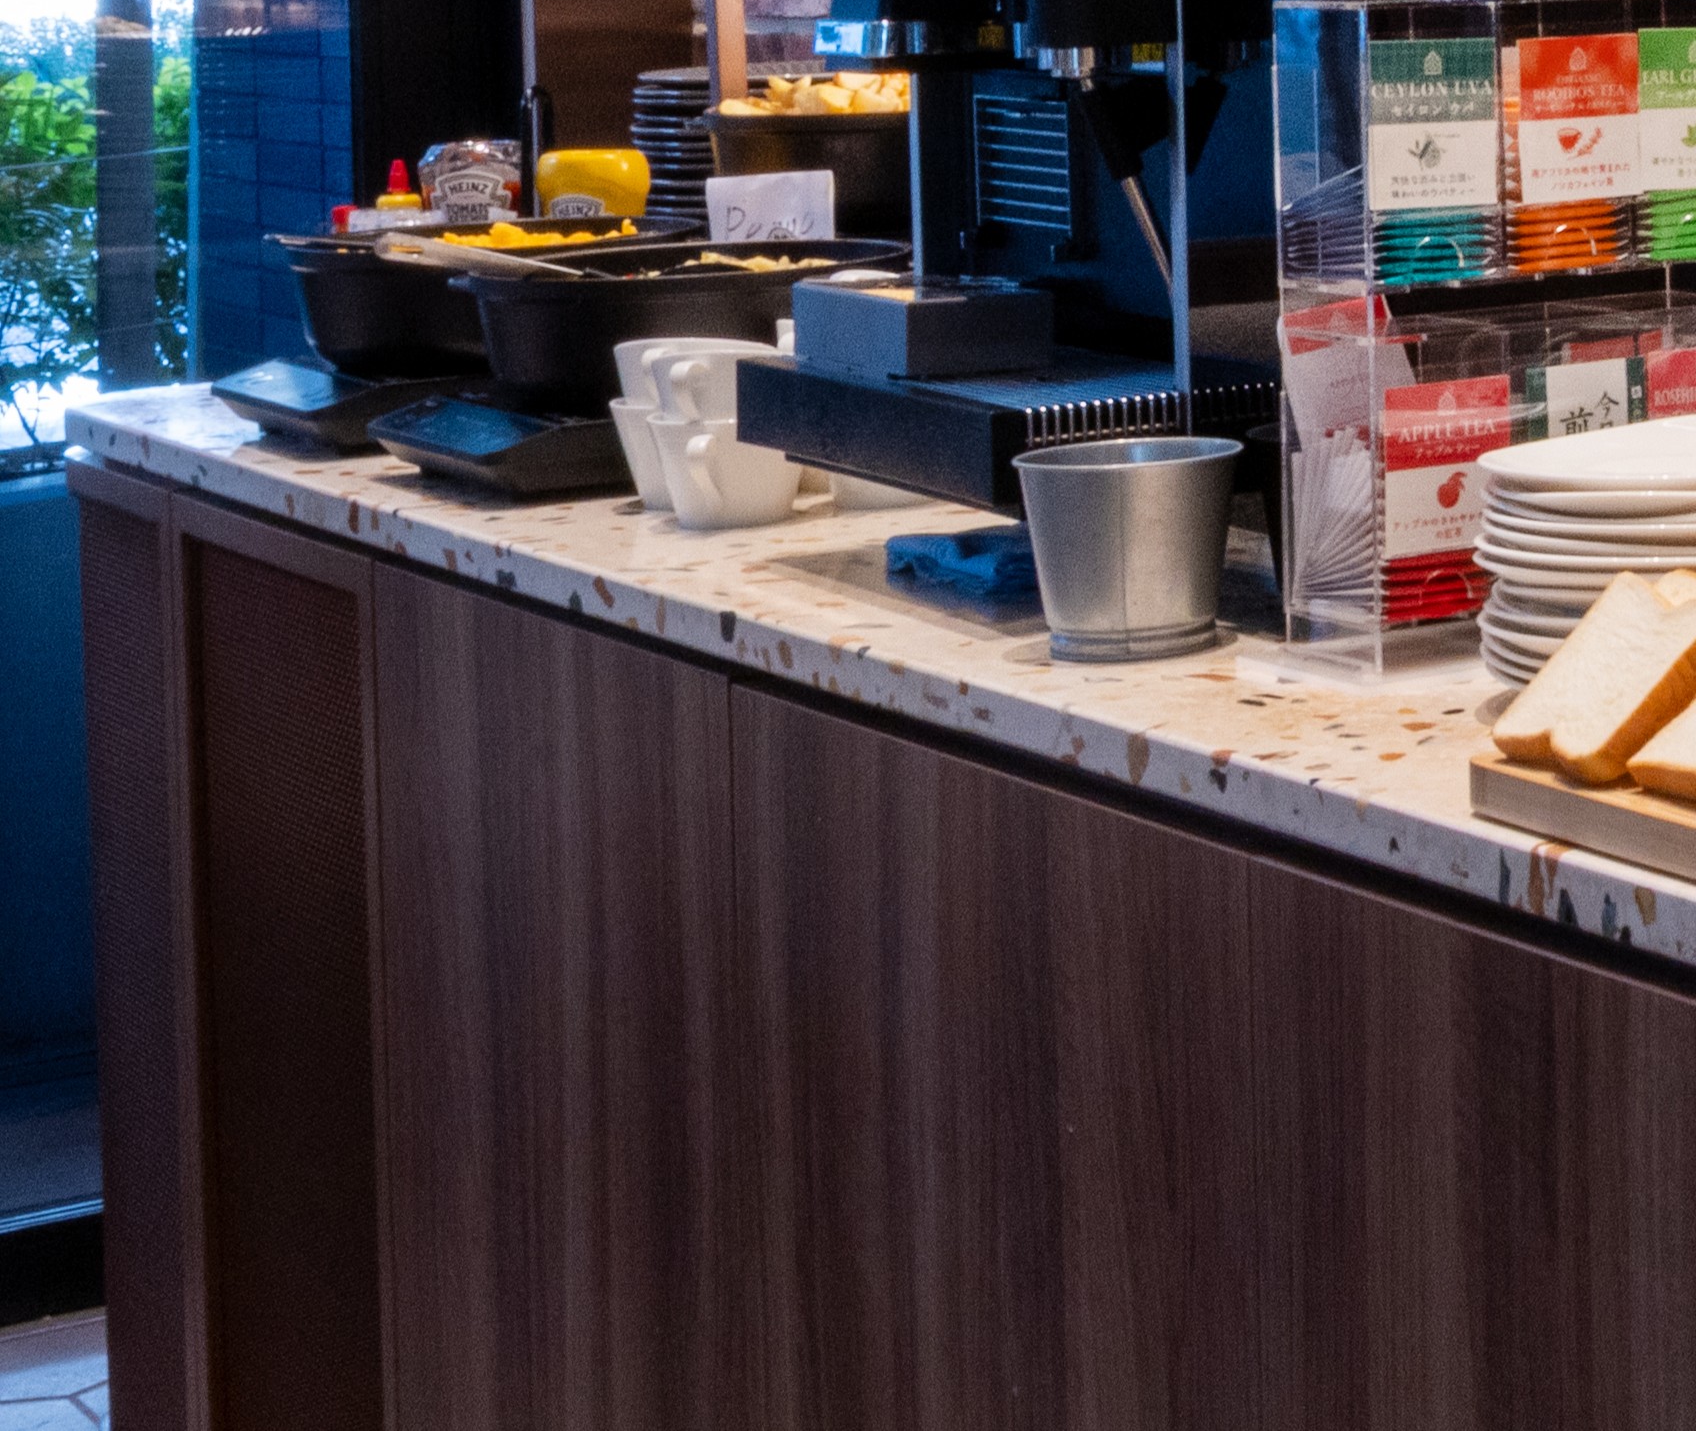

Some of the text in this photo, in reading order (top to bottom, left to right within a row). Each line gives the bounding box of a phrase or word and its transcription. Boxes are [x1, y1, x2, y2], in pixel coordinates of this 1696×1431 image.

[1642, 69, 1678, 84] EARL
[1371, 79, 1493, 99] CEYLON UVA
[449, 182, 489, 203] HEINZ
[1400, 423, 1453, 442] APPLE
